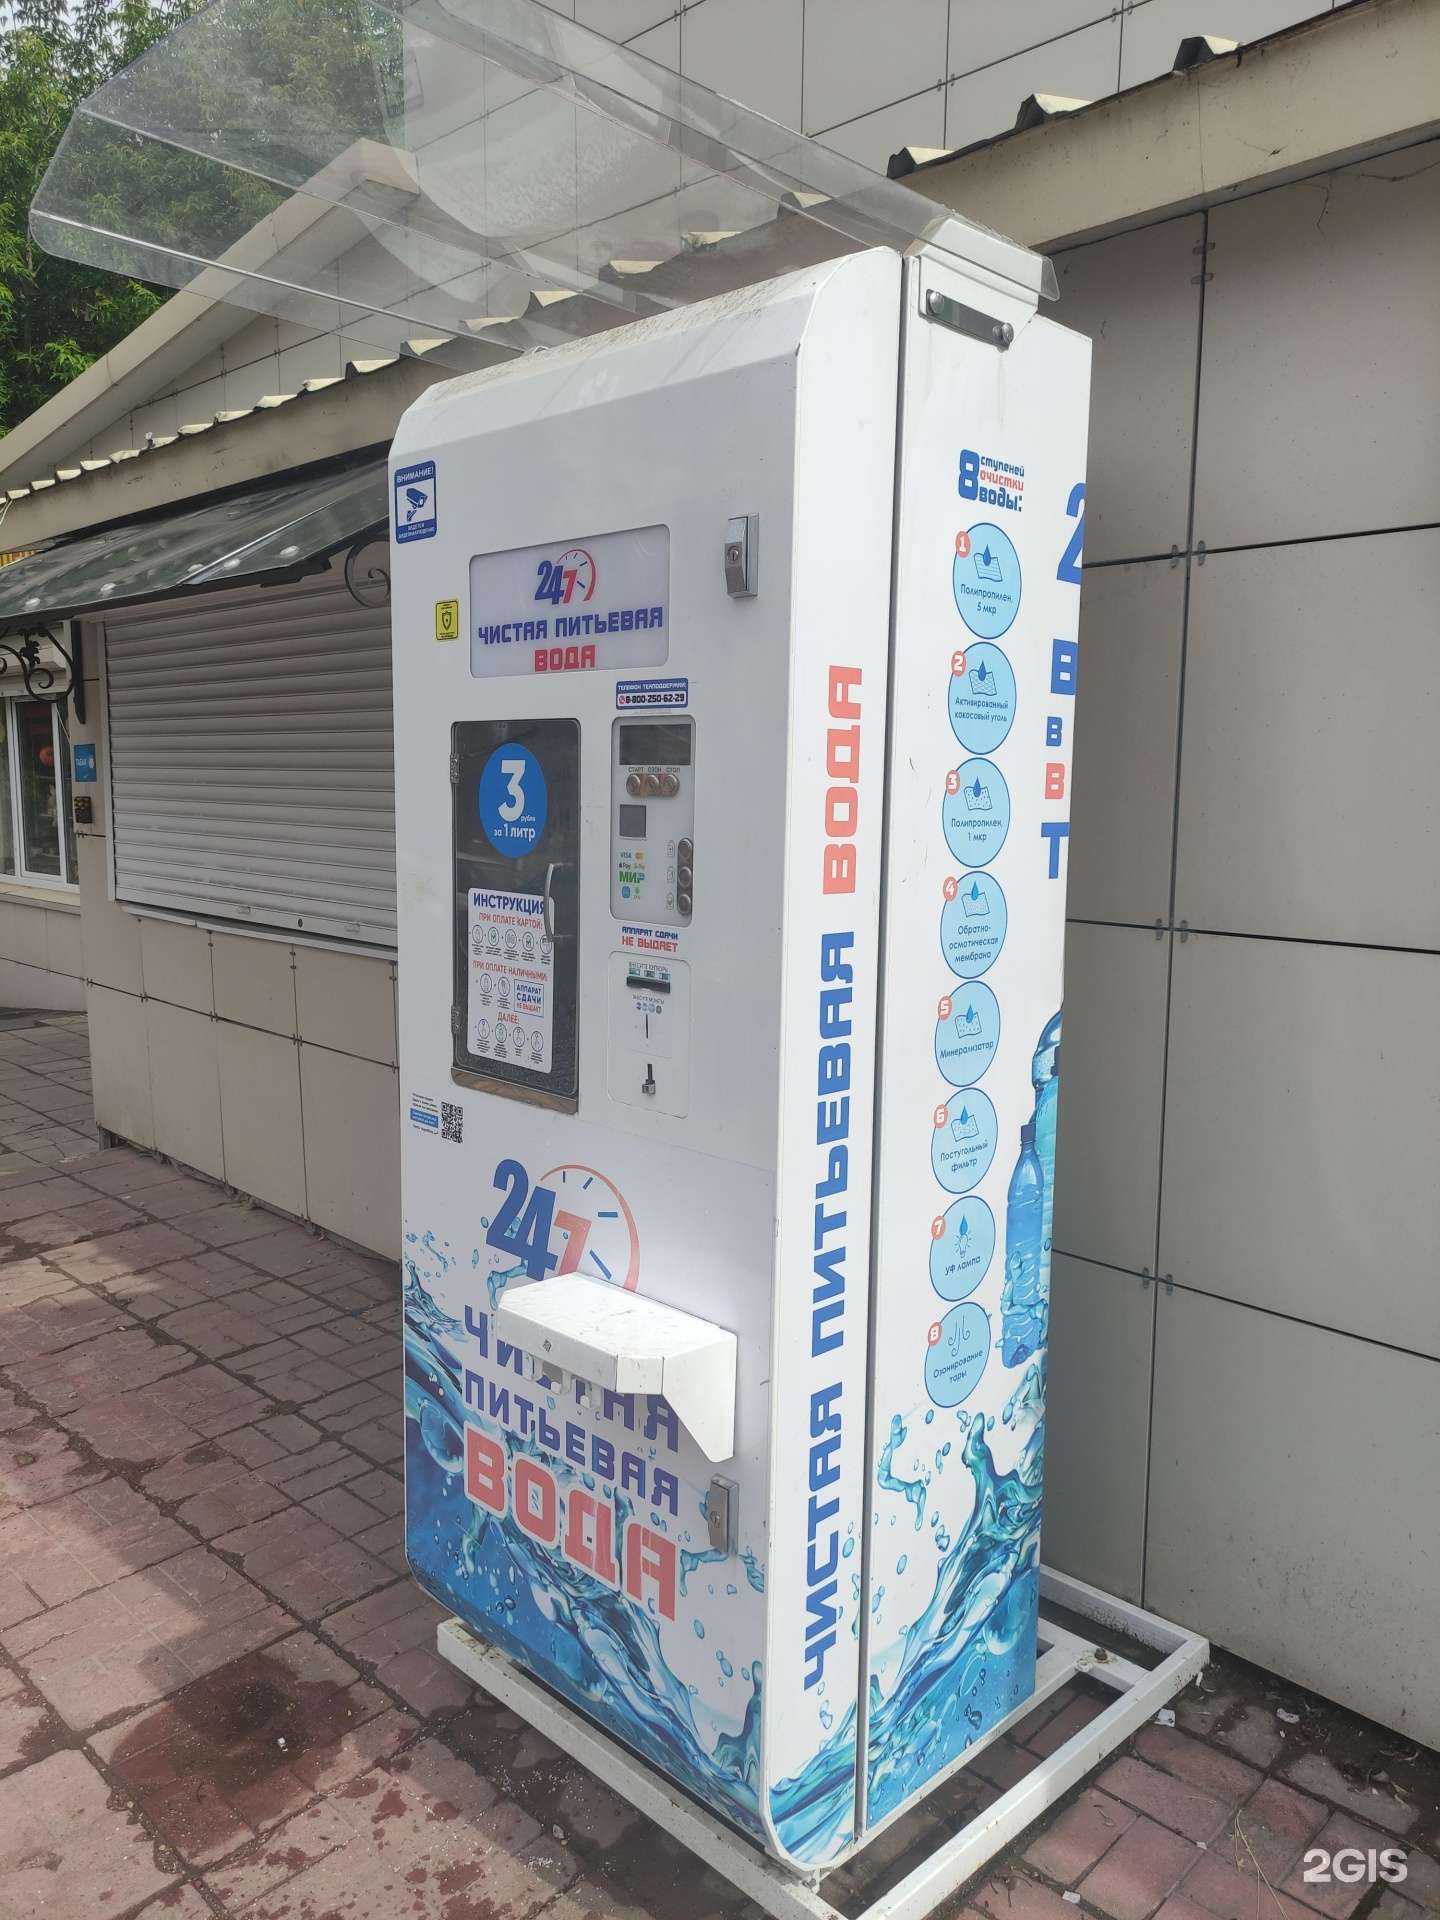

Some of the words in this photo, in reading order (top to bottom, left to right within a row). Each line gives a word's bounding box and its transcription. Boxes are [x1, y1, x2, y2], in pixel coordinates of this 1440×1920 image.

[396, 467, 434, 483] ВНИМАНИЕ!
[959, 449, 980, 501] 8
[981, 456, 1025, 477] ступеней
[980, 470, 1024, 491] очистки
[979, 487, 1023, 512] воды:
[977, 601, 982, 611] 5
[983, 604, 997, 614] мкр
[478, 619, 548, 645] ЧИСТАЯ
[555, 606, 664, 638] ПИТЬЕВАЯ
[534, 644, 596, 673] ВОДА
[954, 655, 963, 672] 2
[955, 697, 1009, 709] Активированный
[954, 711, 990, 721] кокосовый
[822, 665, 863, 895] ВОДА
[948, 773, 957, 791] 3
[498, 759, 526, 822] 3
[494, 828, 502, 837] за
[503, 823, 509, 837] 1
[510, 827, 536, 842] литр
[973, 833, 988, 842] мкр
[619, 870, 646, 883] МИР
[945, 880, 955, 896] 4
[493, 914, 516, 926] ОПЛАТЕ
[622, 926, 652, 937] АППАРАТ
[655, 930, 679, 940] СДАЧИ
[958, 924, 991, 936] Обратно-
[622, 936, 634, 946] НЕ
[637, 938, 679, 952] ВЫДАЕТ
[954, 951, 992, 963] мембрана
[516, 984, 542, 995] АППАРАТ
[516, 993, 542, 1005] СДАЧИ
[939, 998, 949, 1016] 5
[940, 1041, 994, 1059] Минерализатор
[811, 930, 855, 1358] ПИТЬЕВАЯ
[951, 1158, 978, 1173] фильтр
[934, 1218, 943, 1236] 7
[957, 1256, 981, 1272] лампа
[933, 1350, 984, 1378] Озонирование
[949, 1370, 968, 1384] тары
[465, 1368, 680, 1517] ПИТЬЕВАЯ
[464, 1426, 676, 1622] ВОДА
[804, 1381, 843, 1691] ЧИСТАЯ
